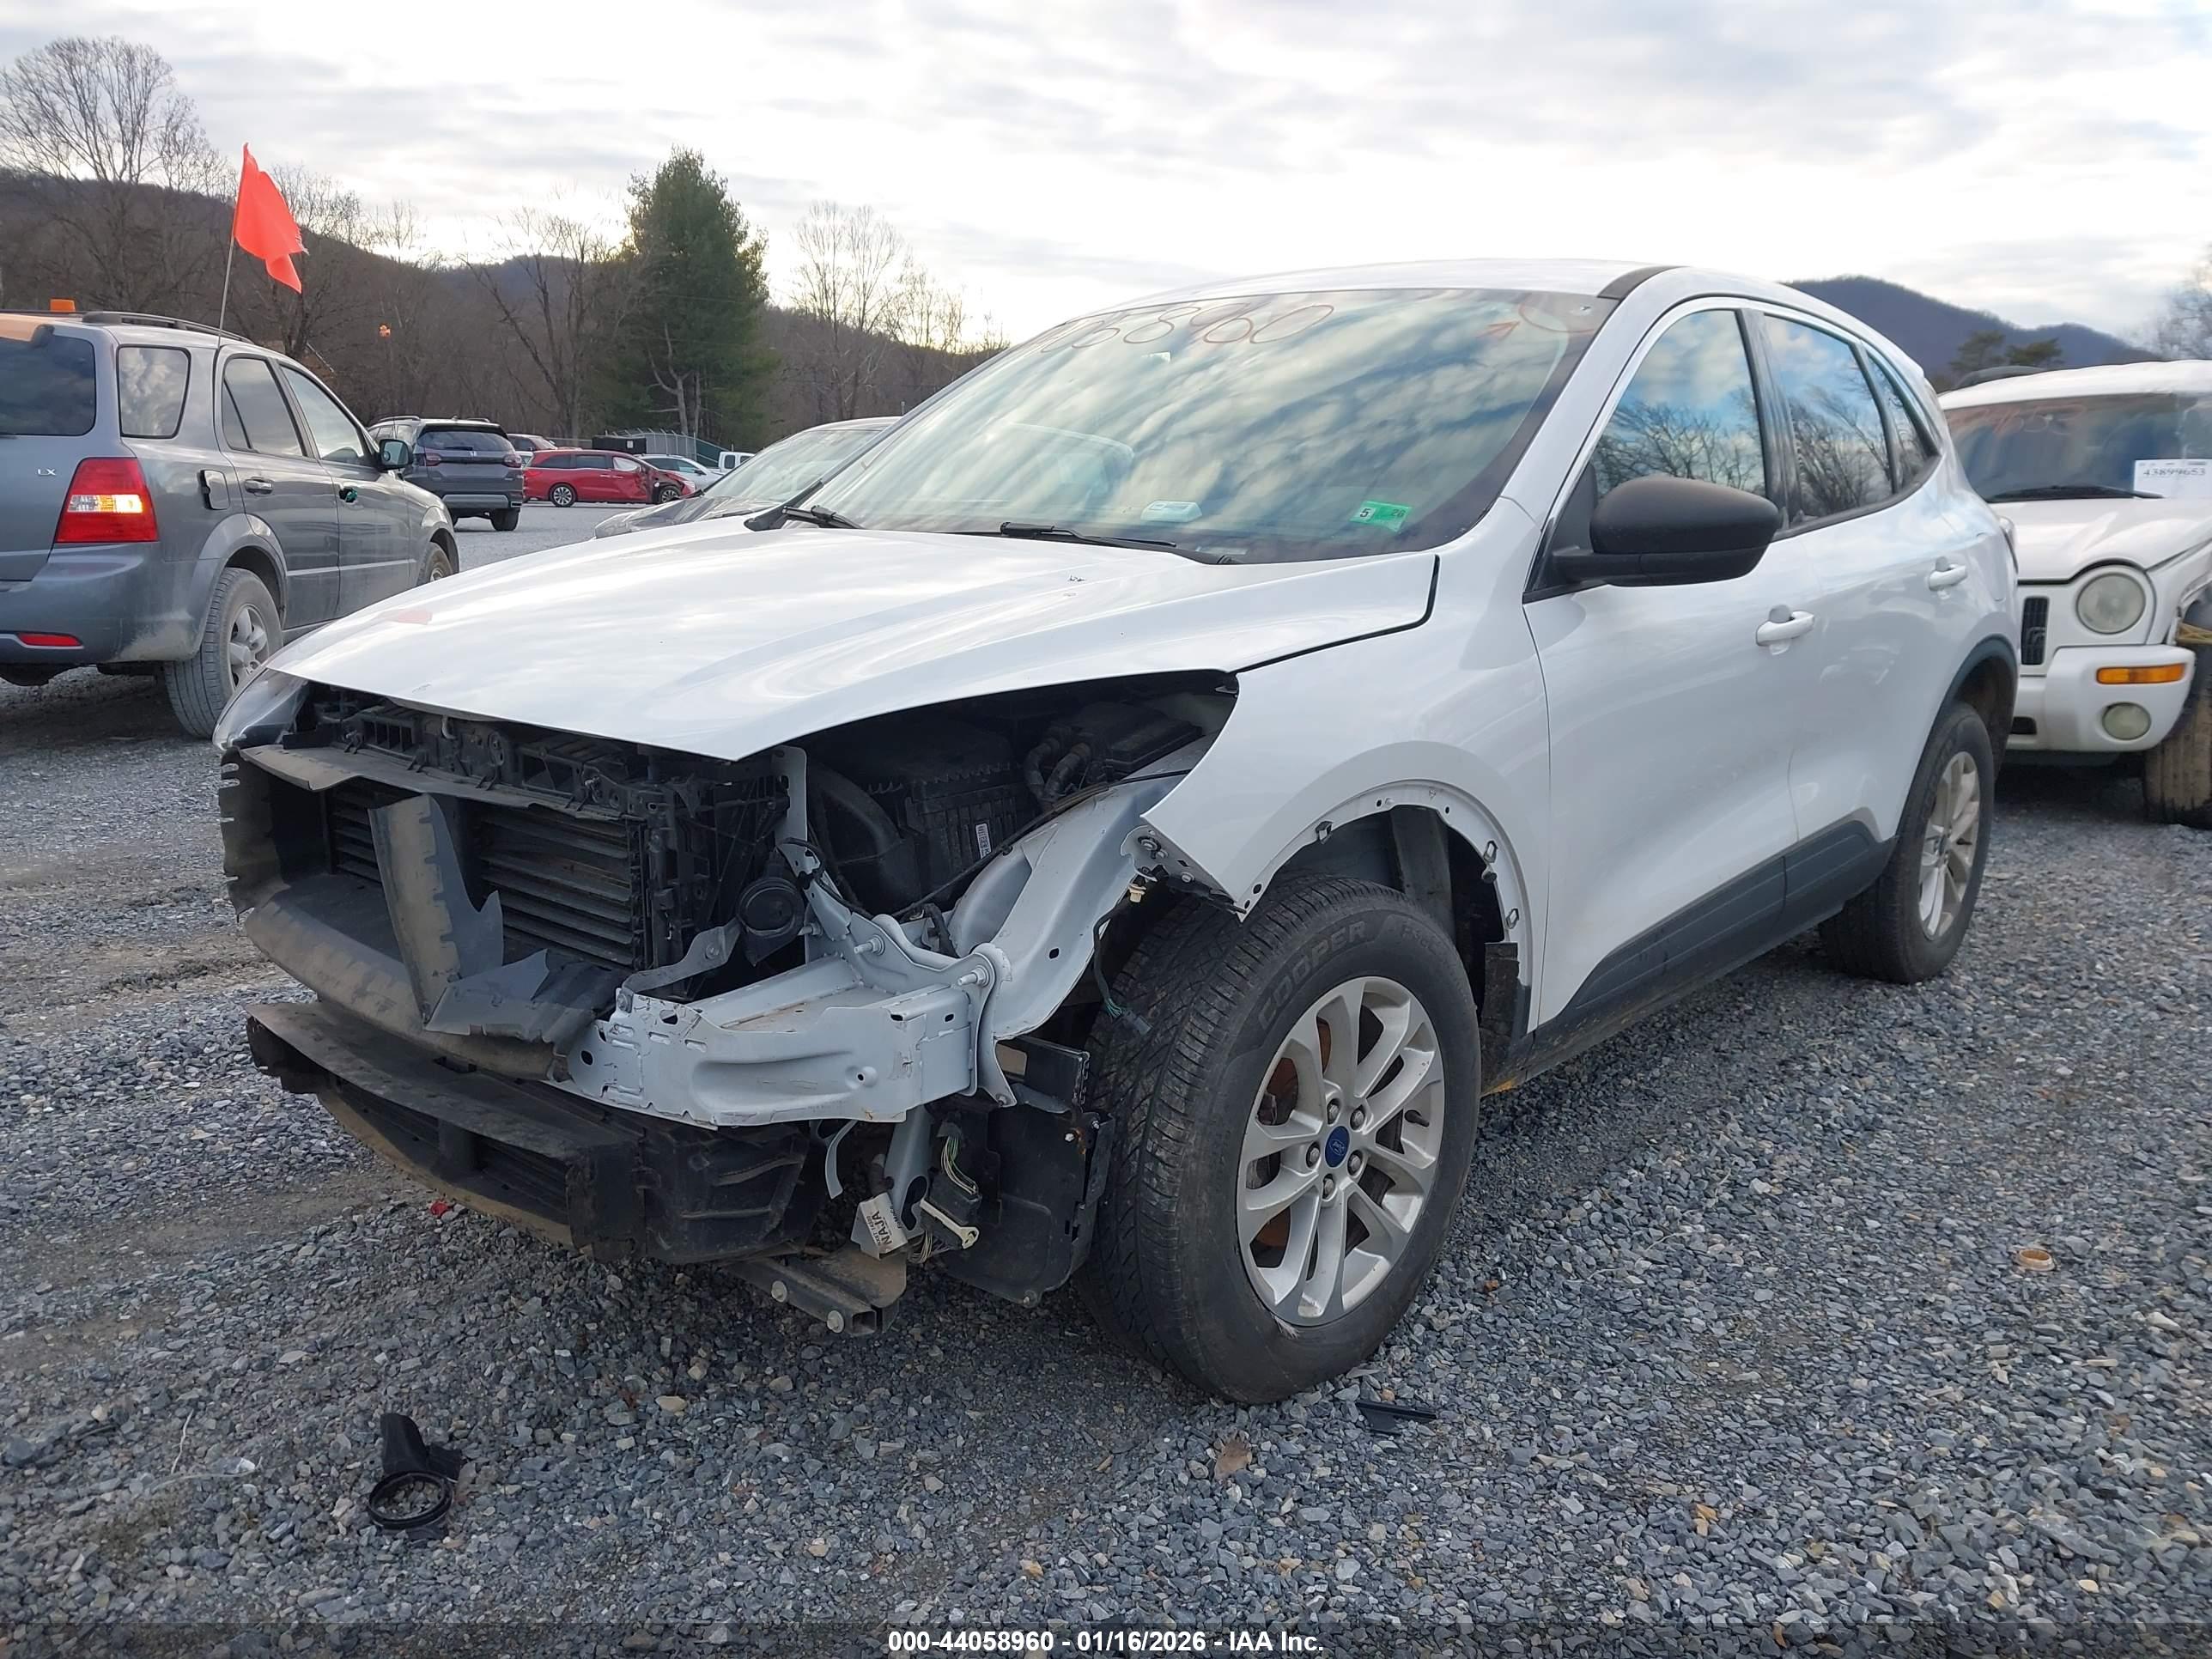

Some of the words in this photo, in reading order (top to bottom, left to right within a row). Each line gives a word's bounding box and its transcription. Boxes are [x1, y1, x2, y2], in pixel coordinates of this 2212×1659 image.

[1359, 507, 1372, 518] 5
[1258, 921, 1366, 1029] COOPER
[872, 1210, 893, 1245] NAJA
